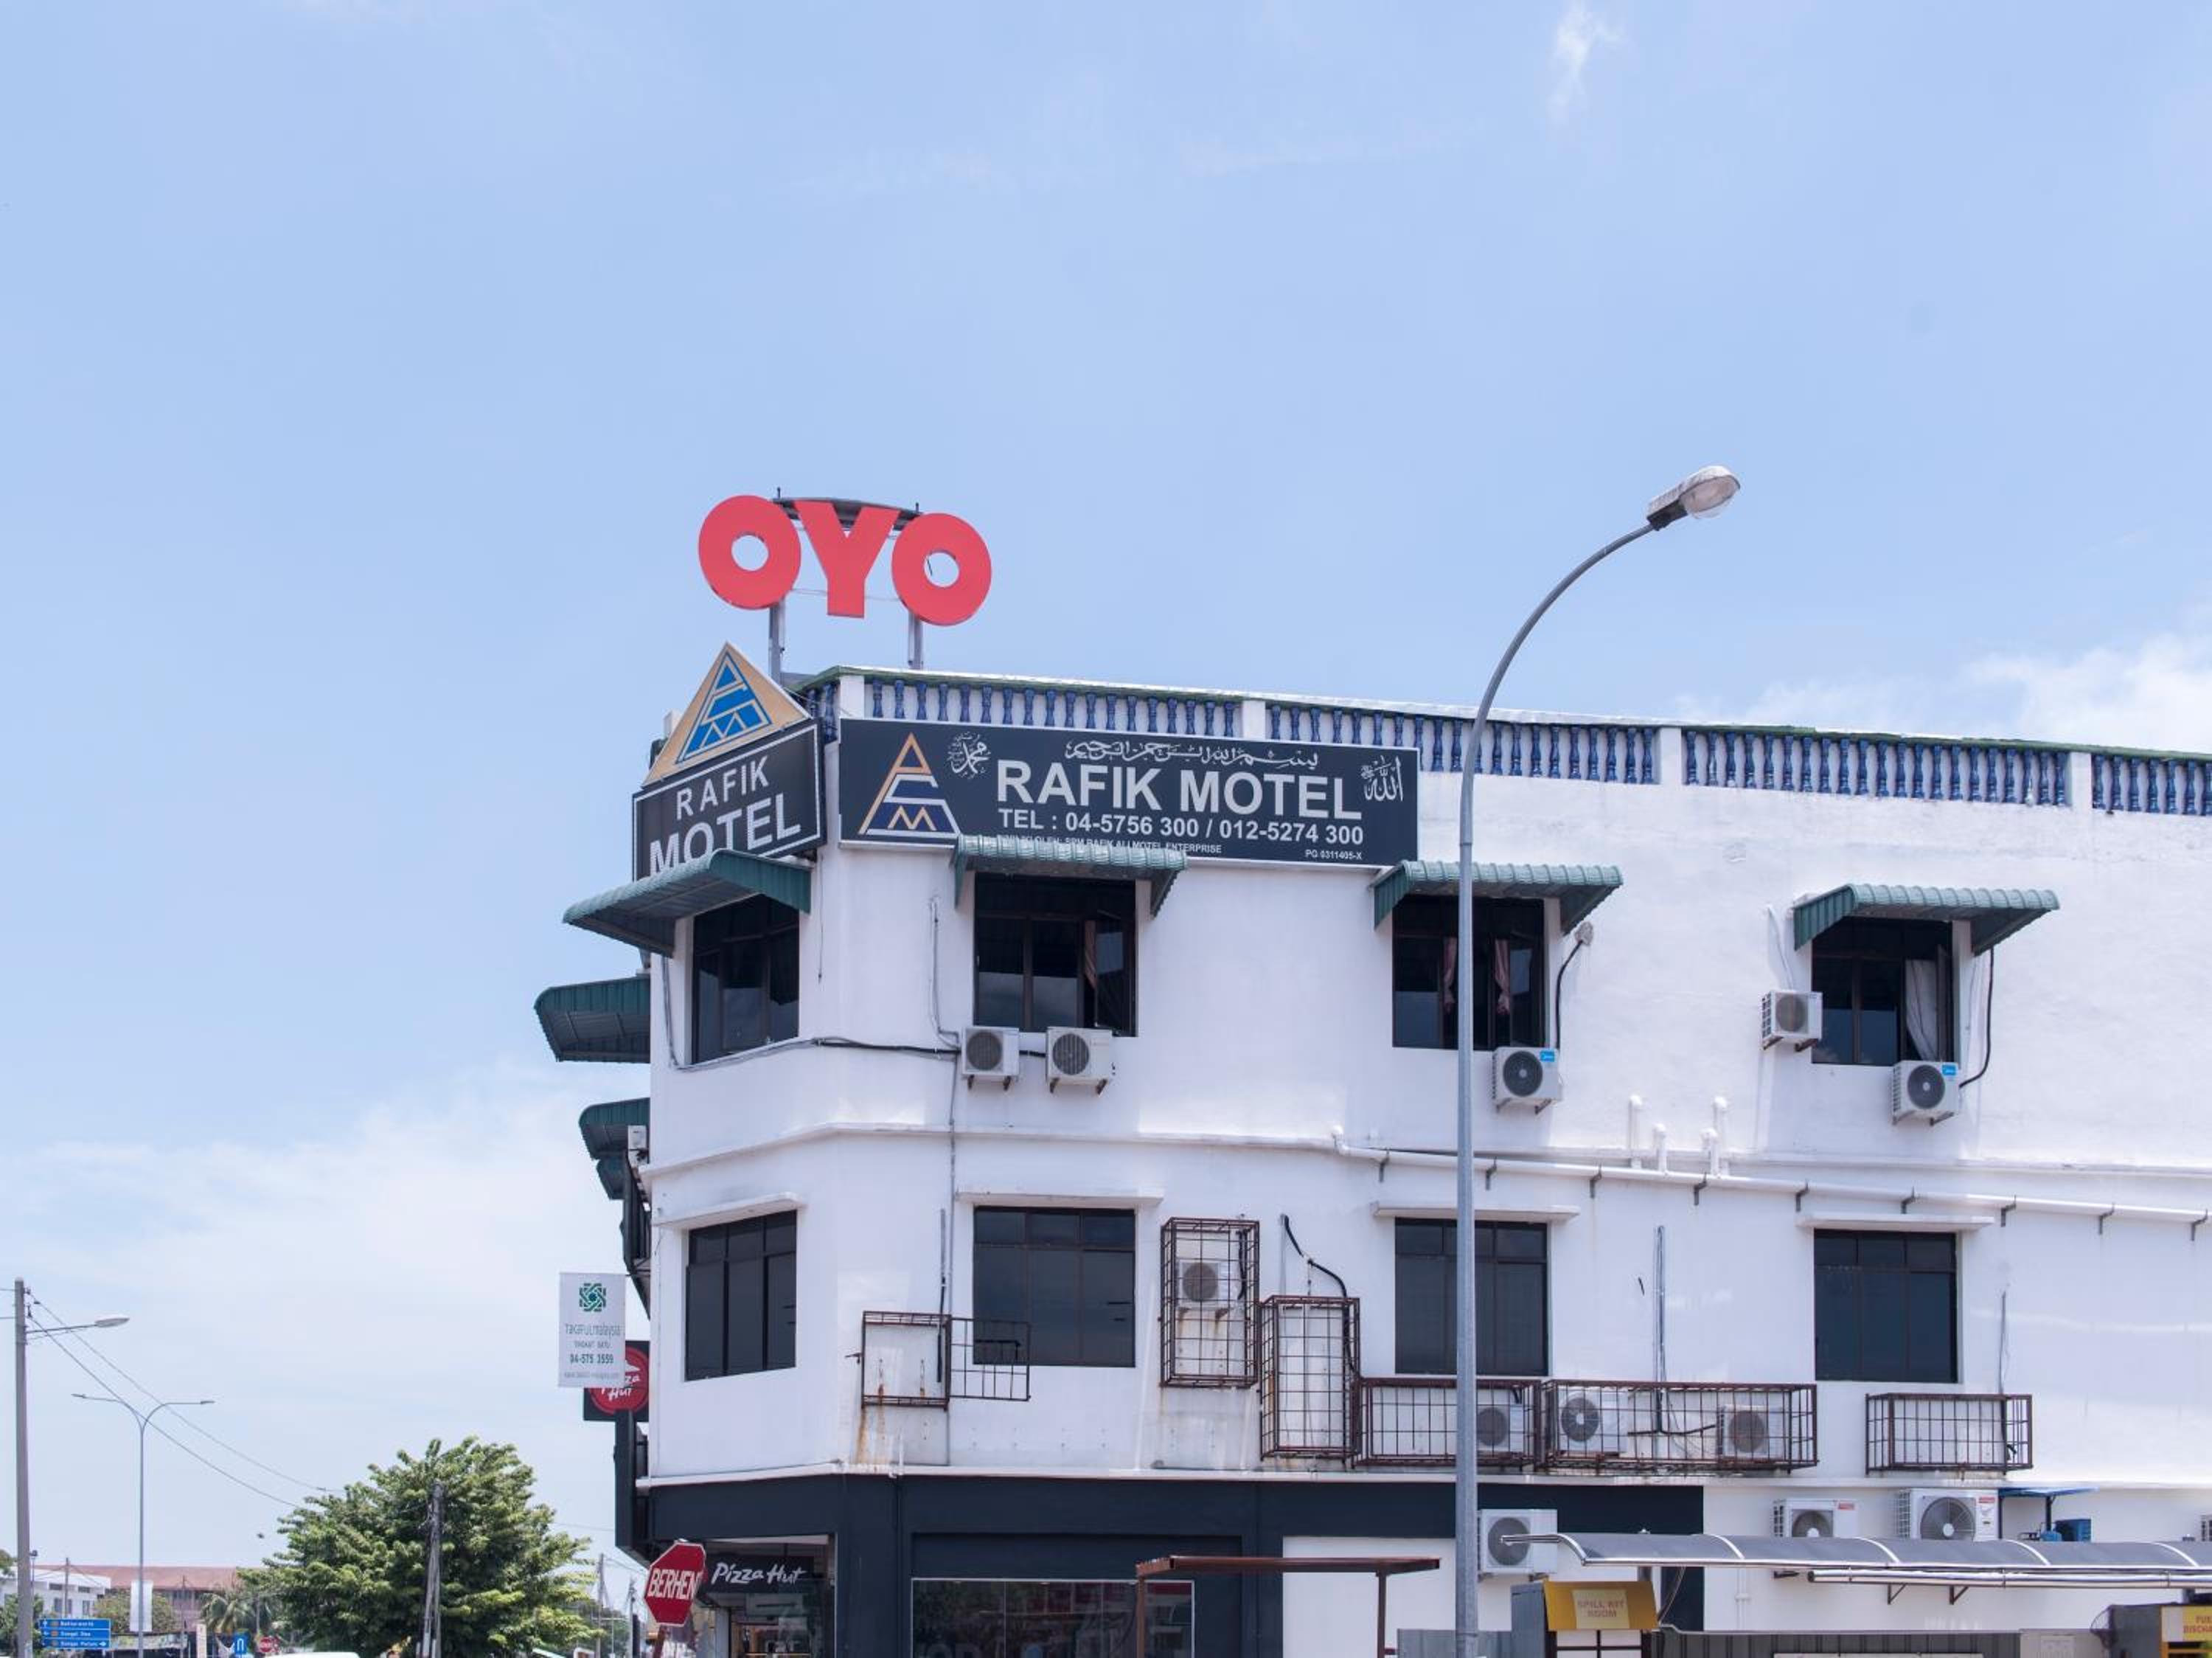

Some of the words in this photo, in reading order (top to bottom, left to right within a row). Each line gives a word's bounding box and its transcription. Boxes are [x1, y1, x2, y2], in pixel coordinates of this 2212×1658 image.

[698, 495, 992, 626] OYO
[676, 755, 769, 820] RAFIK
[998, 759, 1162, 811] RAFIK
[1180, 770, 1362, 820] MOTEL
[650, 793, 801, 877] MOTEL
[998, 808, 1044, 830] TEL
[1065, 812, 1152, 835] 04-5756
[1160, 816, 1199, 837] 300
[1220, 819, 1318, 843] 012-5274
[1326, 825, 1363, 844] 300
[711, 1562, 764, 1584] Pizza
[767, 1564, 807, 1584] Hut
